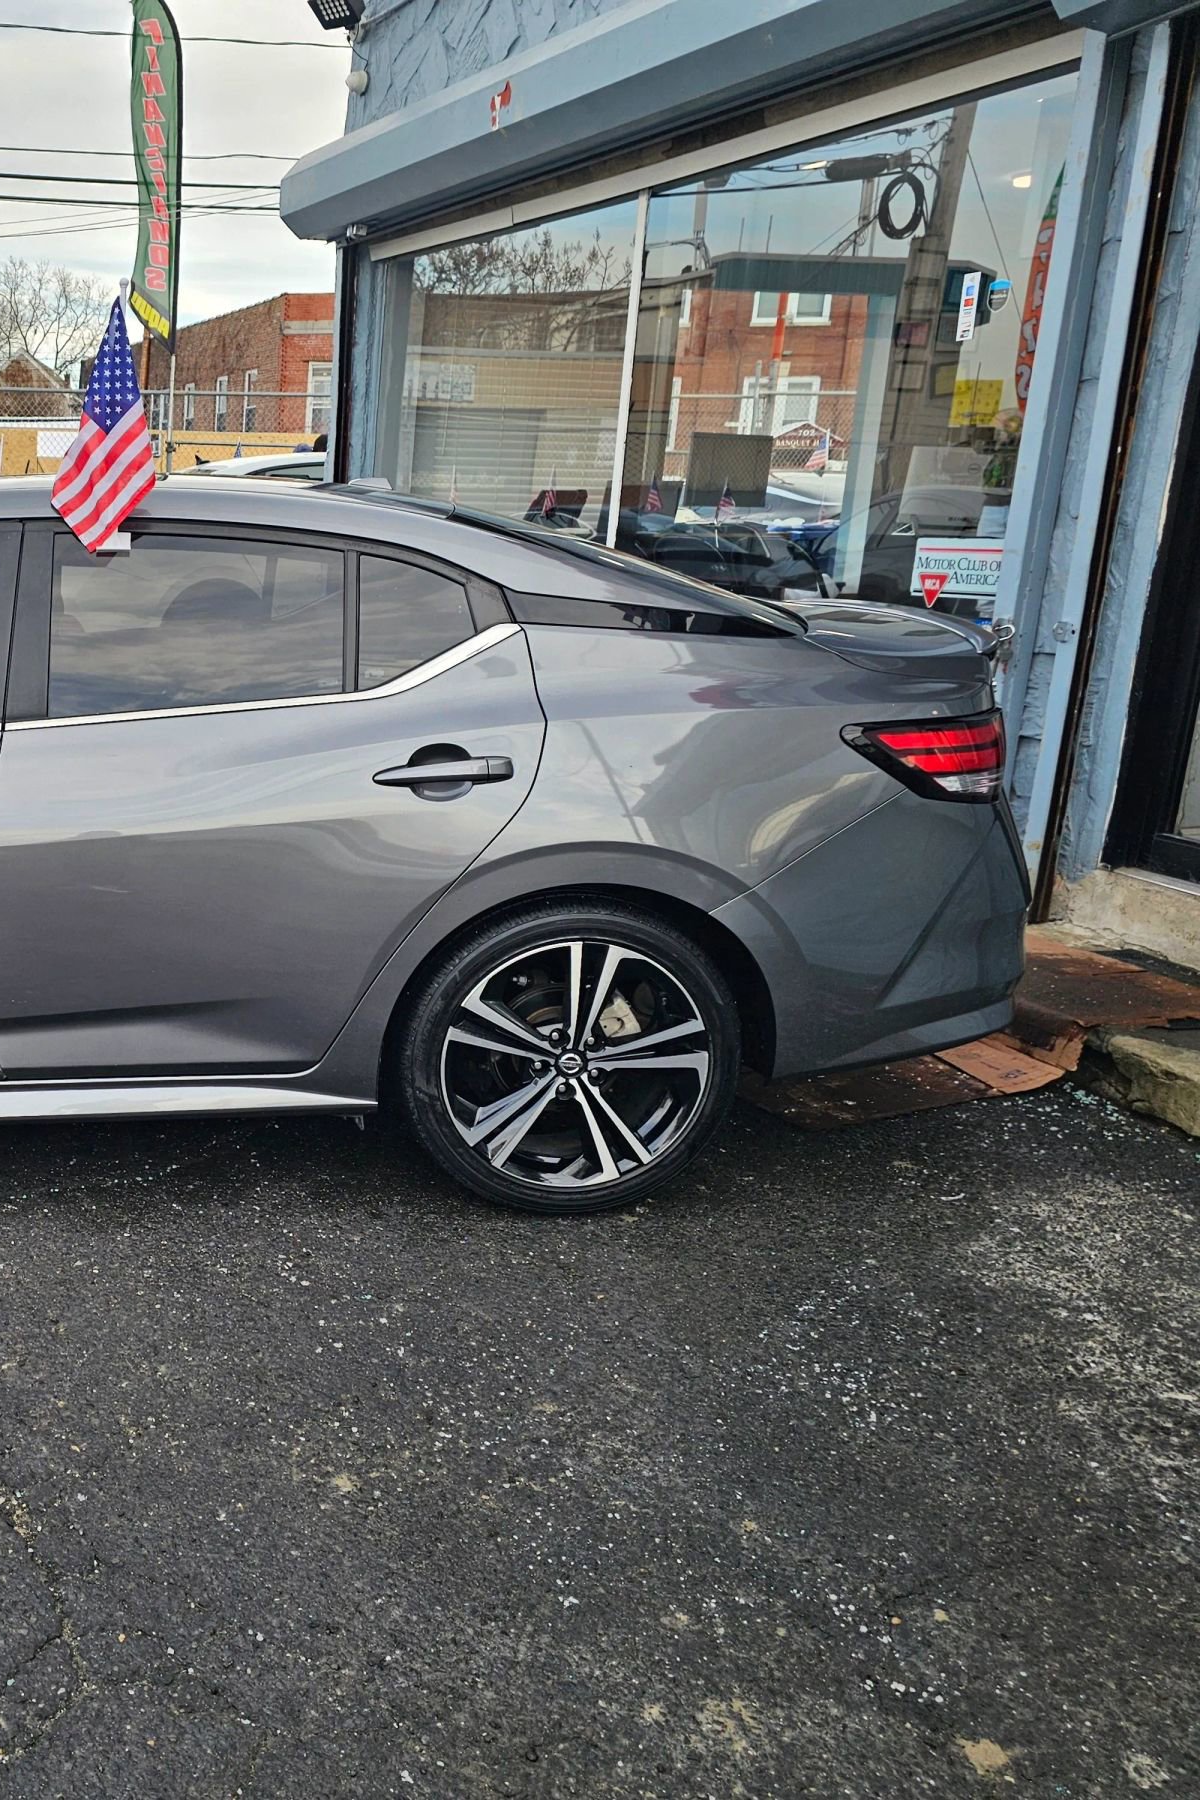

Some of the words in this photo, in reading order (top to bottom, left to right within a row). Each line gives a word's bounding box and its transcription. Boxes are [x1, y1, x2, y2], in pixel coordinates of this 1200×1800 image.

[775, 439, 810, 448] BANQUET
[917, 556, 956, 570] MOTOR
[957, 558, 988, 571] CLUB
